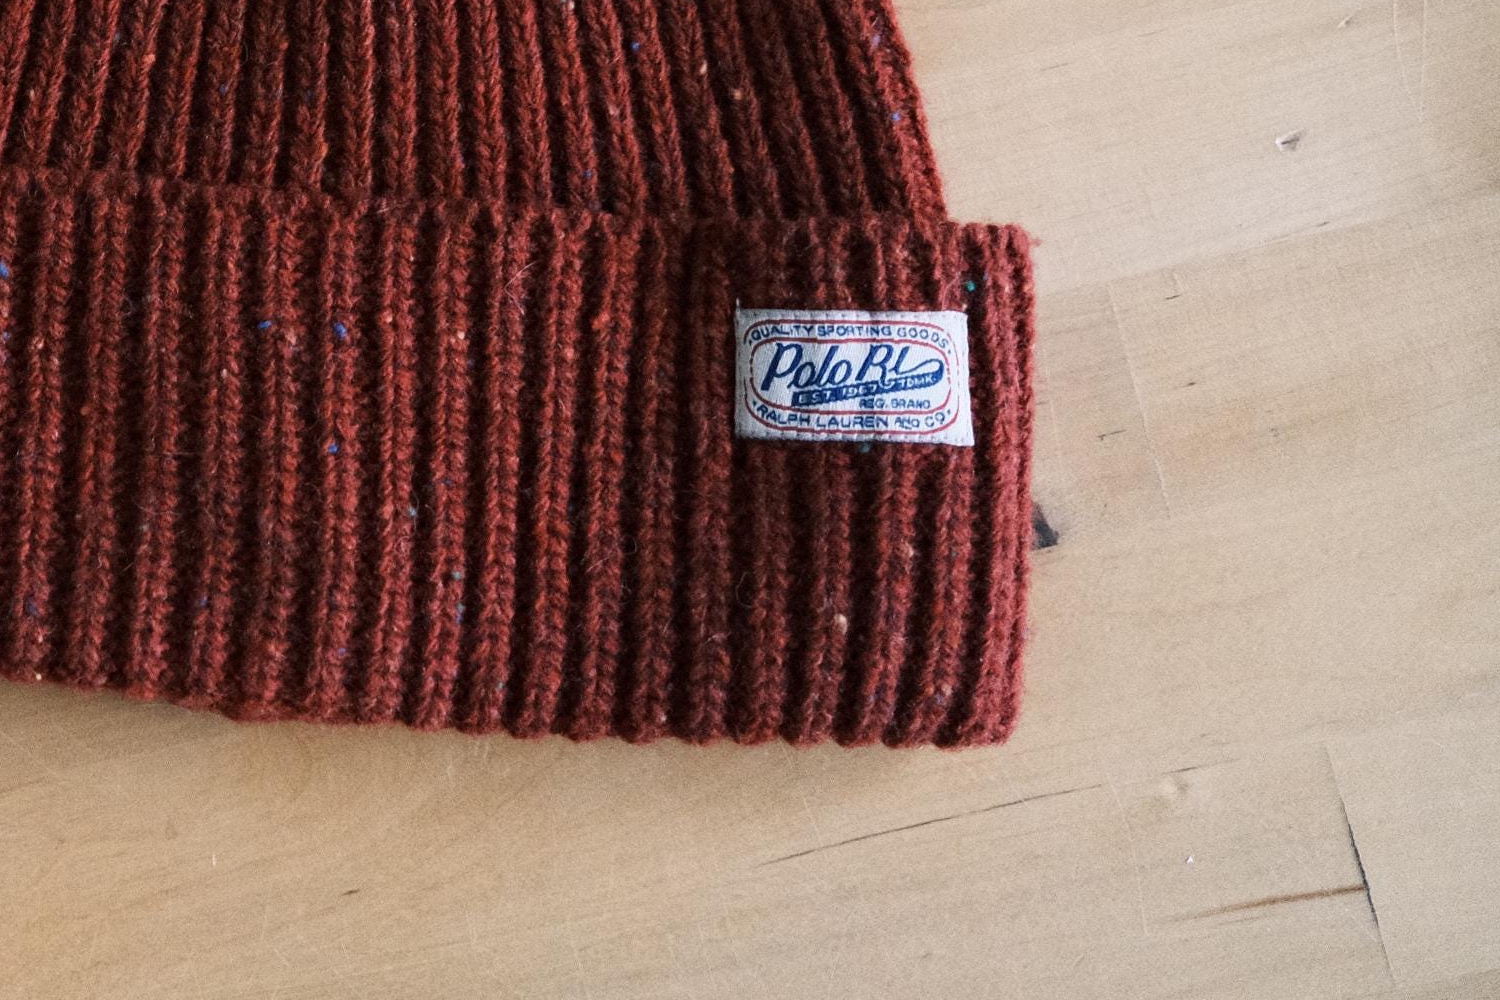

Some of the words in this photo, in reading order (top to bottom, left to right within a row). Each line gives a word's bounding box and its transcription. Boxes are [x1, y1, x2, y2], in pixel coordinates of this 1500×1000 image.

[751, 325, 814, 341] QUALITY
[817, 325, 893, 337] SPORTING
[897, 327, 949, 348] GOODS
[760, 342, 853, 391] Polo
[855, 343, 944, 387] RL
[842, 384, 877, 397] 1967
[891, 398, 931, 409] BRAND
[756, 404, 811, 426] RALPH
[816, 415, 889, 428] LAUREN
